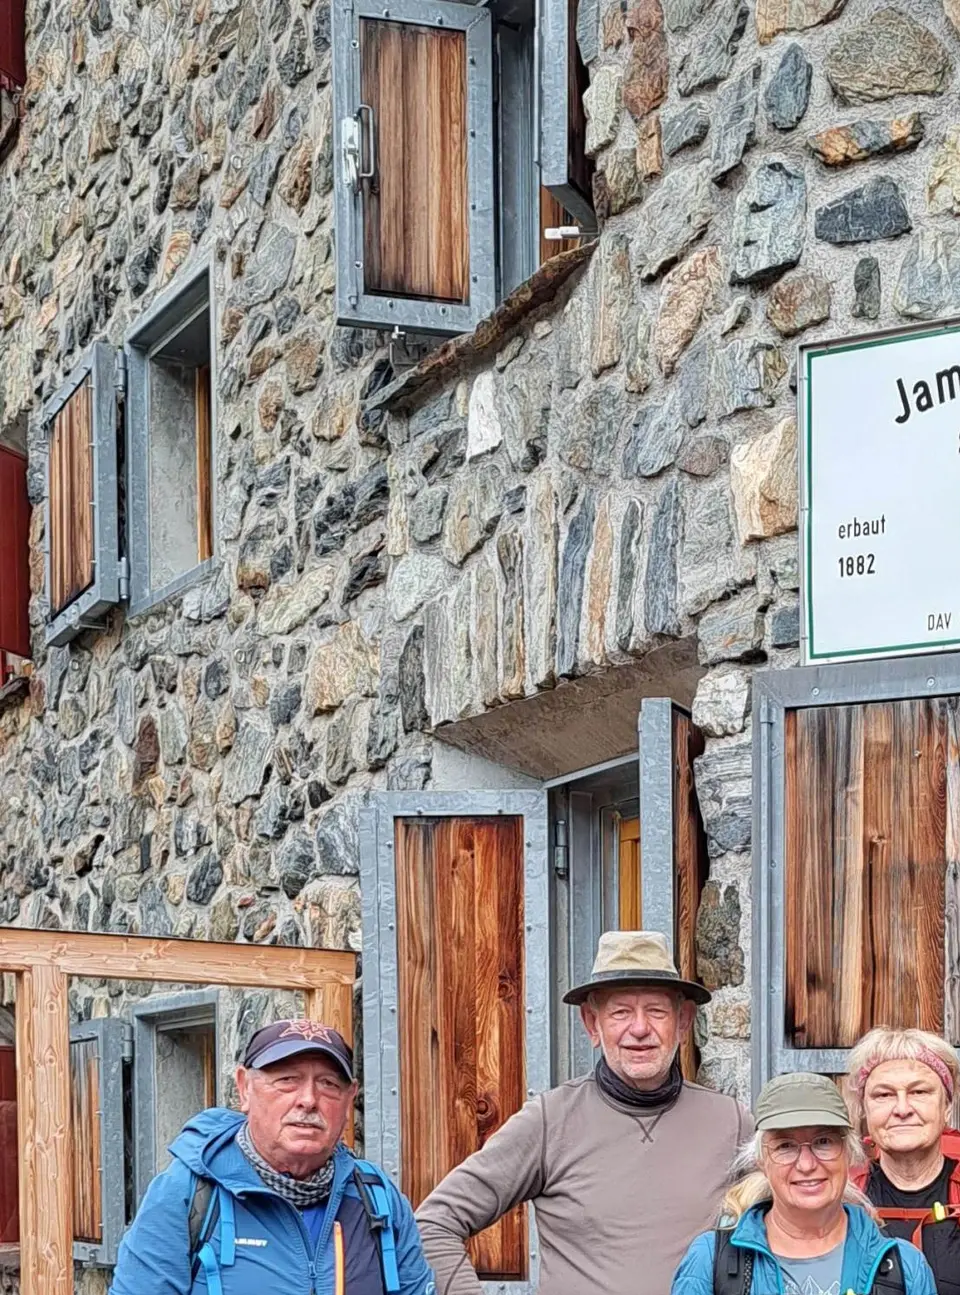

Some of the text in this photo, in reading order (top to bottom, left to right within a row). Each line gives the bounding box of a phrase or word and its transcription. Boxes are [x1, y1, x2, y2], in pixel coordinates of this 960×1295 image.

[838, 513, 886, 540] erbaut
[838, 553, 876, 578] 1882
[927, 612, 952, 631] DAV
